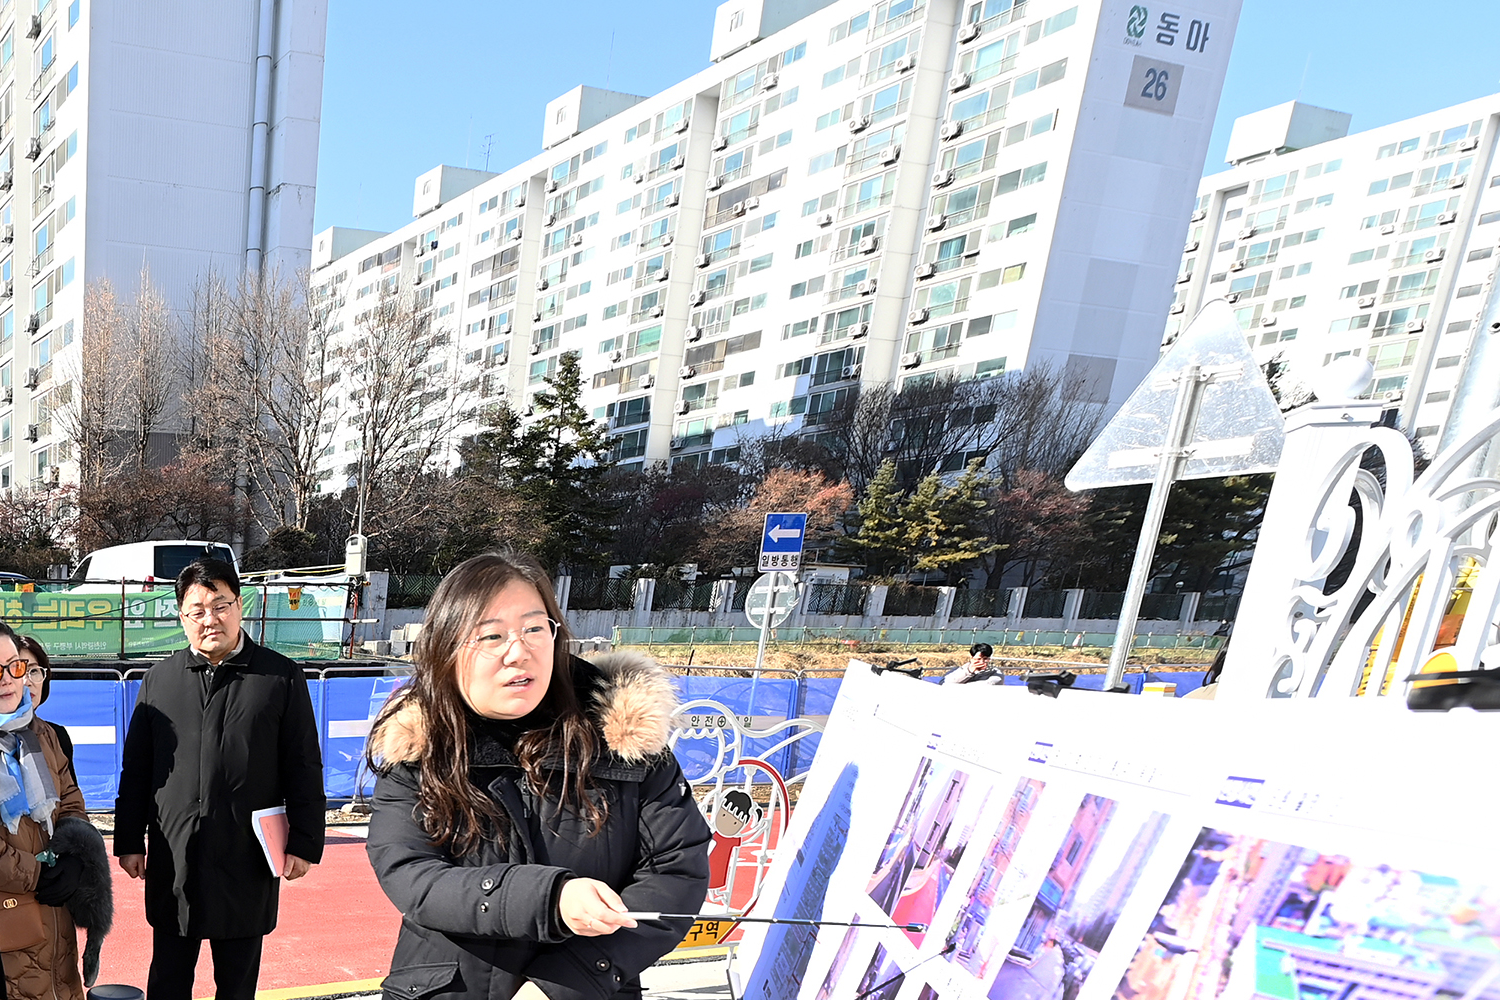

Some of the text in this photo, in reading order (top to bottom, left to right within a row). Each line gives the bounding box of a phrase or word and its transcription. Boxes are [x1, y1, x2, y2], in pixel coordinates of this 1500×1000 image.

[1156, 12, 1210, 53] 동아
[1141, 67, 1169, 101] 26
[762, 555, 799, 567] 일방통행
[691, 715, 714, 727] 안전
[683, 921, 720, 941] 구역
